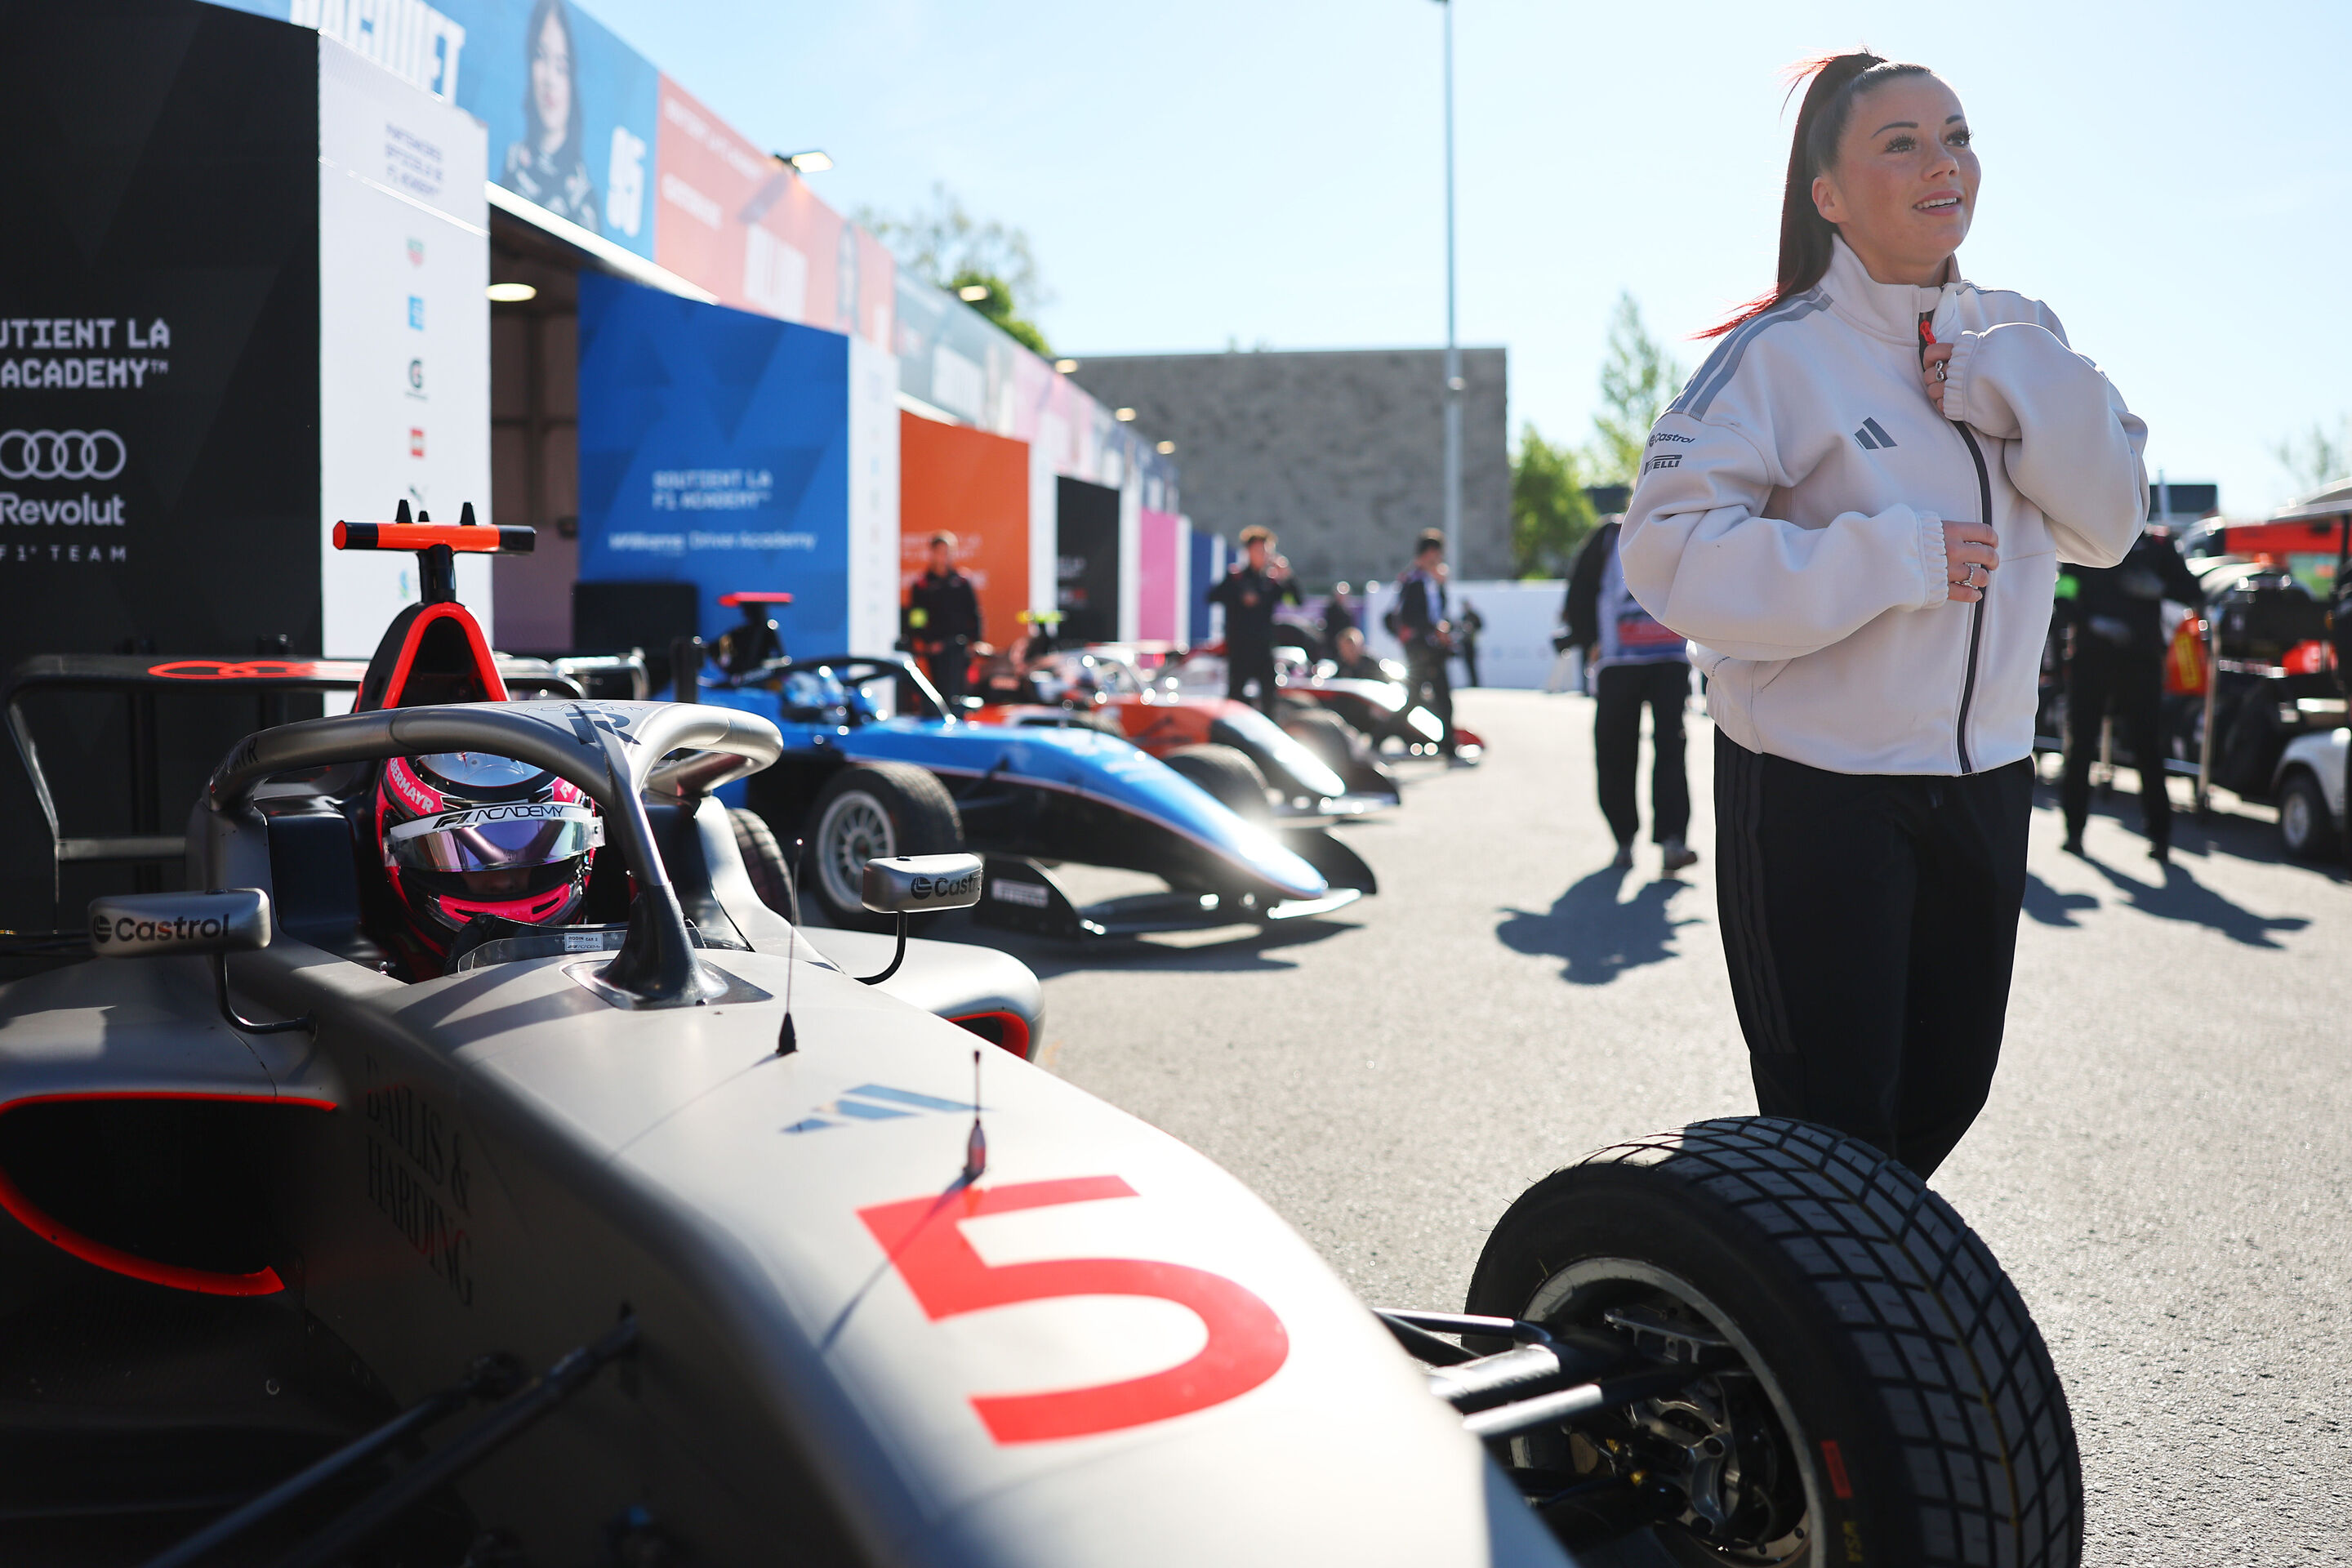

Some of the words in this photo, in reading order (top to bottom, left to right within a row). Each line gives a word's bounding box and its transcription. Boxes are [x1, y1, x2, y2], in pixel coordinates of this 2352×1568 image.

[128, 318, 170, 349] LA
[0, 492, 126, 525] Revolut
[50, 545, 126, 562] TEAM
[474, 806, 564, 822] ACADEMY
[115, 914, 229, 942] Castrol
[853, 1174, 1290, 1446] 5
